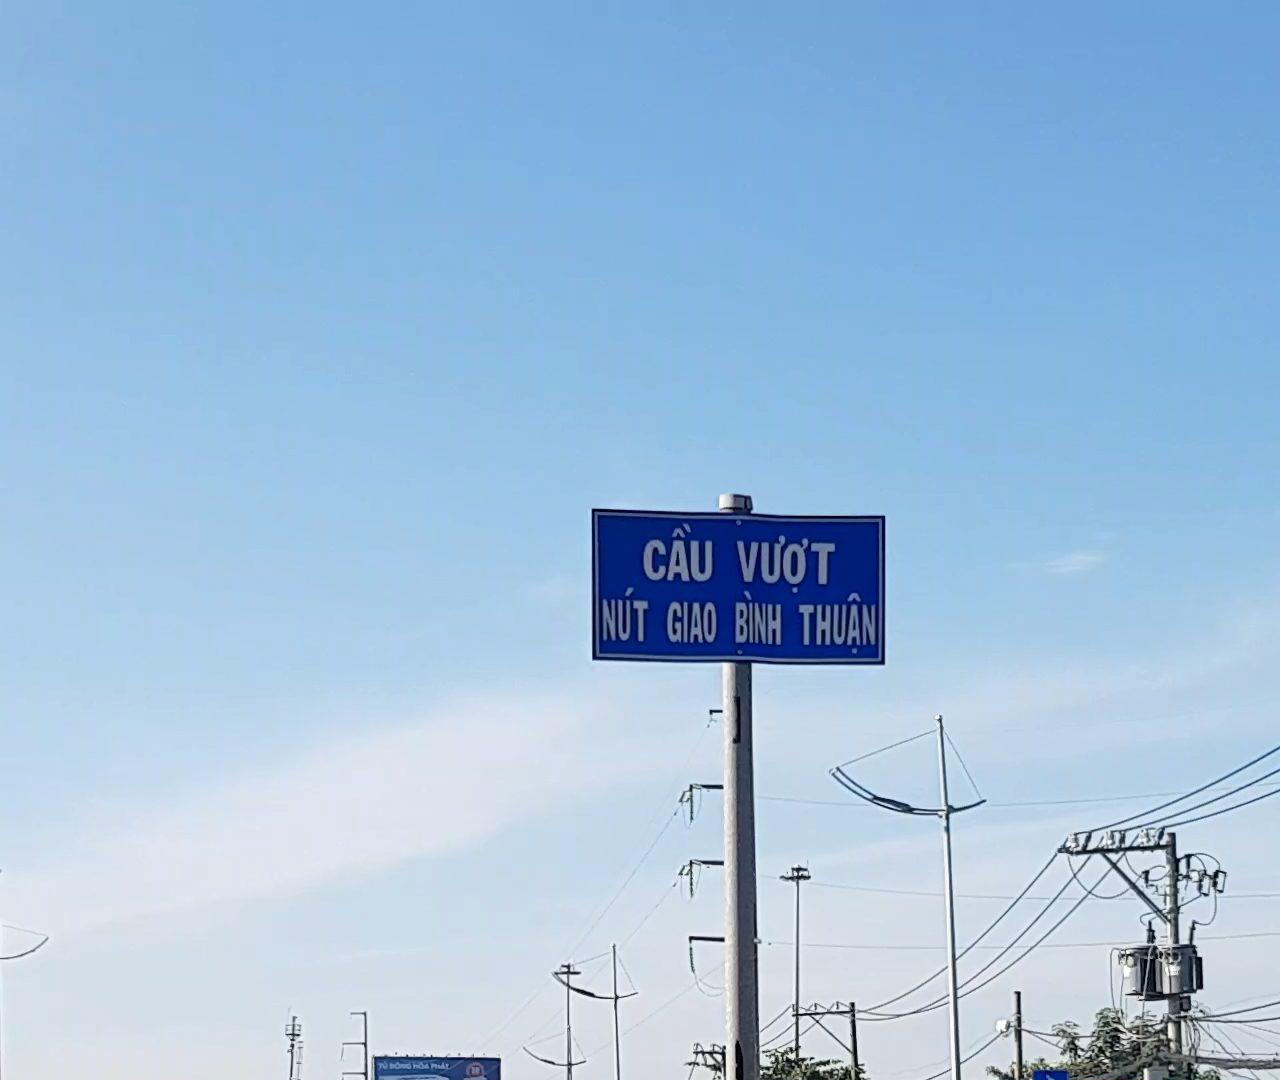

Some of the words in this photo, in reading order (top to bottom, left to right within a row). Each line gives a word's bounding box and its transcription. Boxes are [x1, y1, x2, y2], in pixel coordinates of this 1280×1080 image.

[643, 523, 713, 582] CẦU
[736, 535, 836, 593] VƯỢT
[602, 587, 649, 642] NÚT
[667, 601, 717, 643] GIAO
[735, 590, 782, 645] BÌNH
[798, 593, 876, 654] THUẬN
